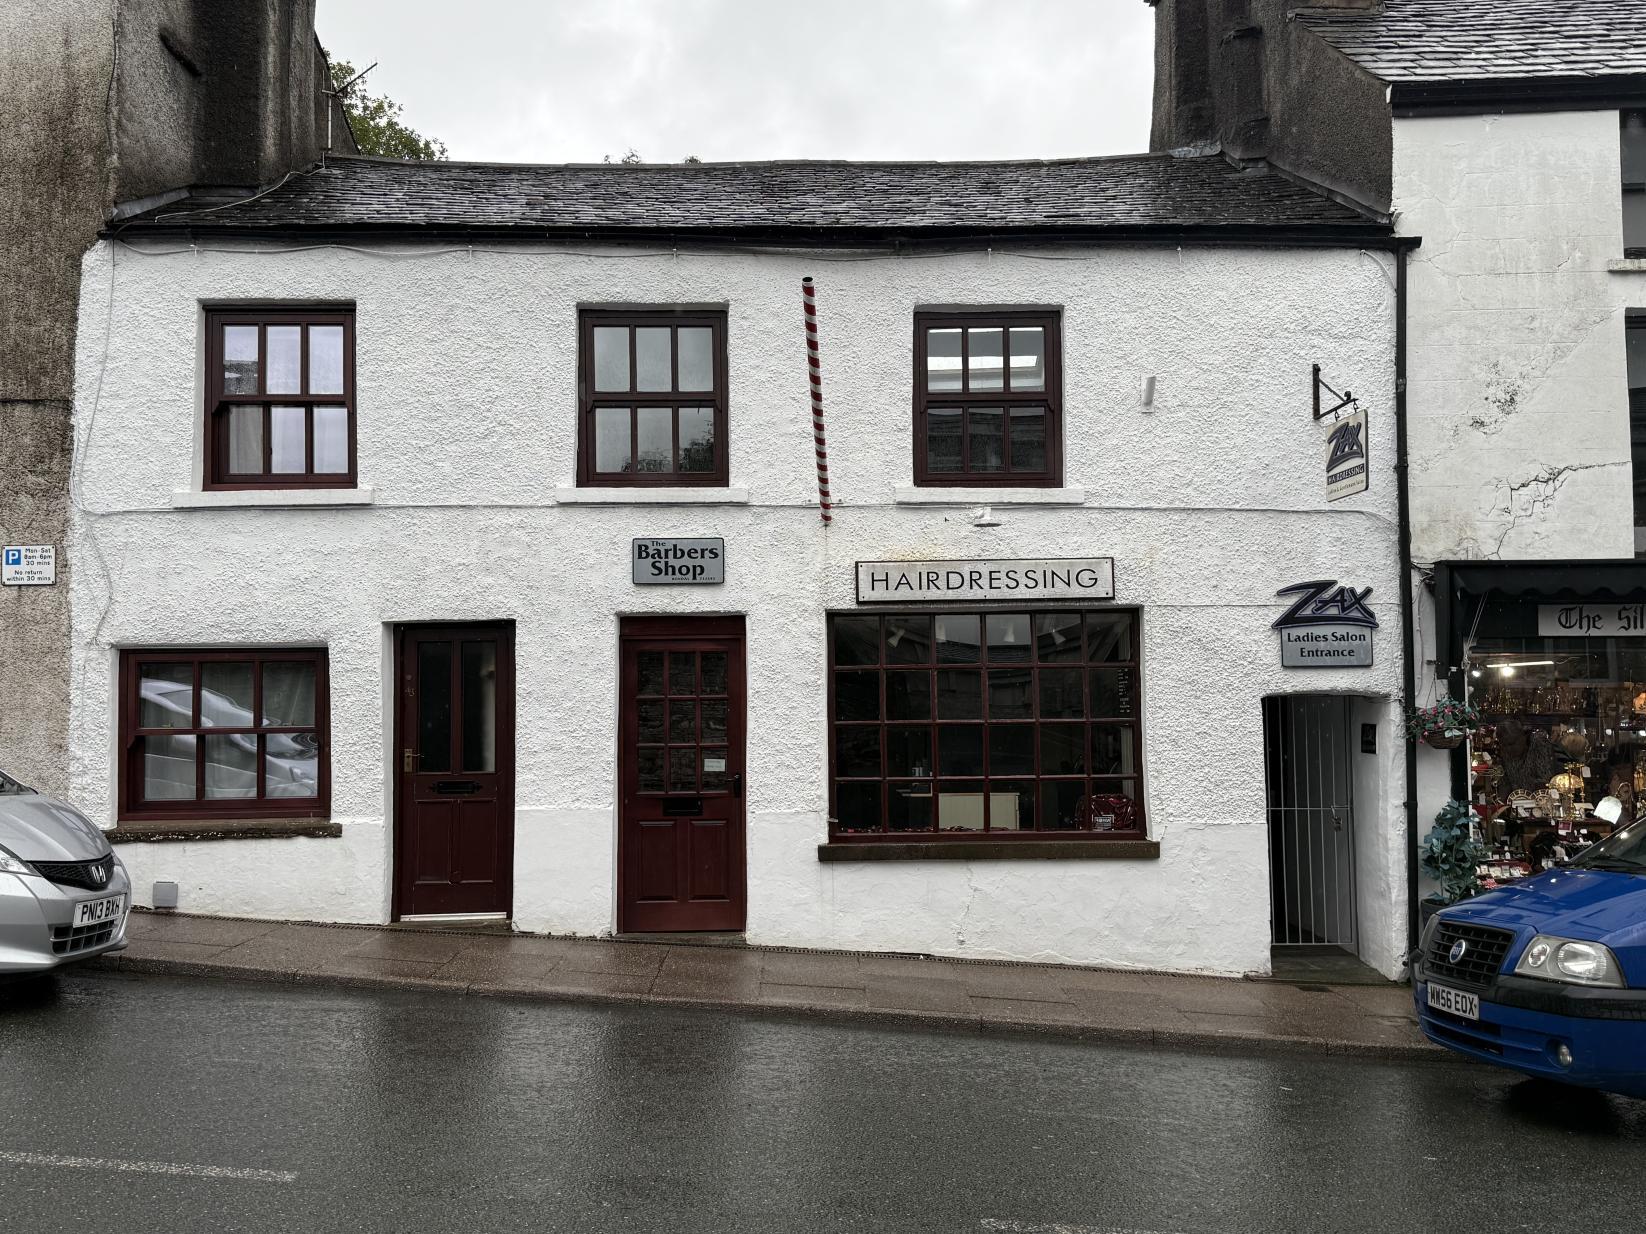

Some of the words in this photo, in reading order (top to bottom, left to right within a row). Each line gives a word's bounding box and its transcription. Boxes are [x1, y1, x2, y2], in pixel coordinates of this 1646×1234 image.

[8, 550, 19, 564] P
[637, 544, 720, 560] Barbers
[650, 560, 705, 581] Shop
[870, 568, 1099, 591] HAIRDRESSING
[1557, 605, 1603, 634] The
[1287, 632, 1329, 643] Ladies
[1331, 631, 1366, 642] Salon
[1300, 647, 1355, 658] Entrance
[80, 901, 104, 923] PN13
[1454, 992, 1475, 1017] EOX
